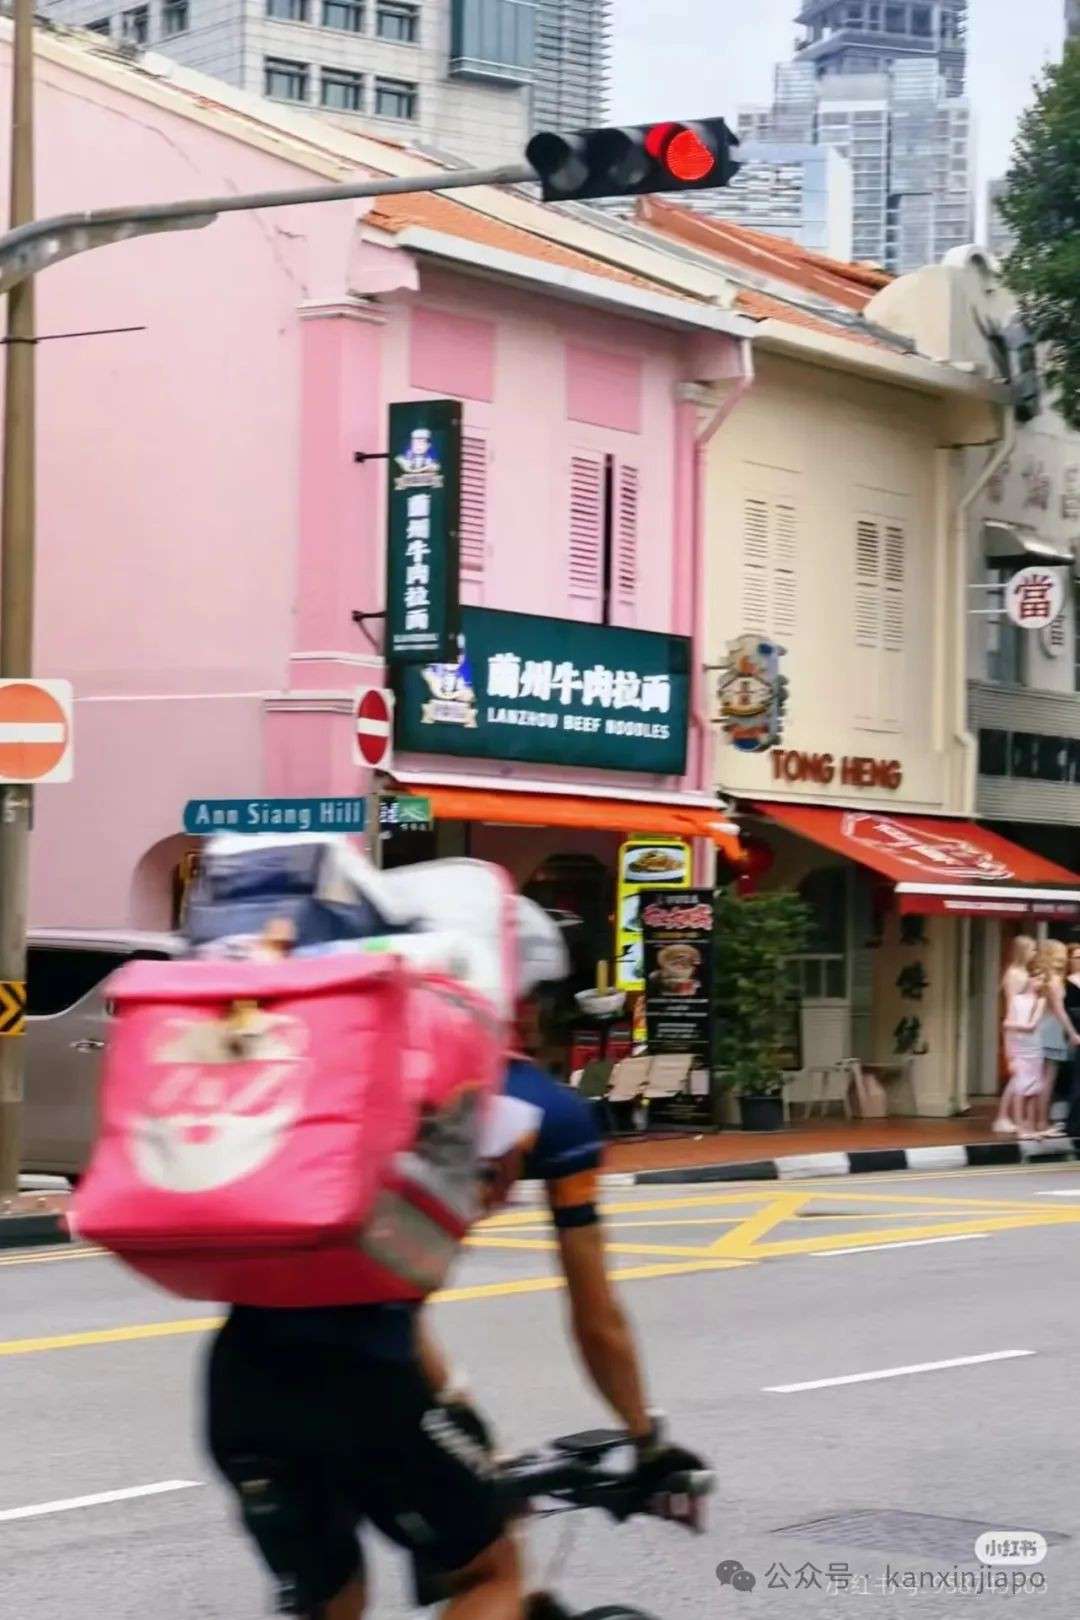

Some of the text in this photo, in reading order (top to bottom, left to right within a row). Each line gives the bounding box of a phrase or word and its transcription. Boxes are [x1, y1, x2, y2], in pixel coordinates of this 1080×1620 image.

[1014, 574, 1054, 619] 當
[487, 707, 558, 729] LANZHOU
[563, 715, 602, 733] BEEF
[605, 719, 671, 740] NOODLES
[771, 749, 903, 790] TONG HENG
[195, 804, 239, 825] Ann
[248, 803, 311, 829] Siang
[320, 801, 360, 823] Hill
